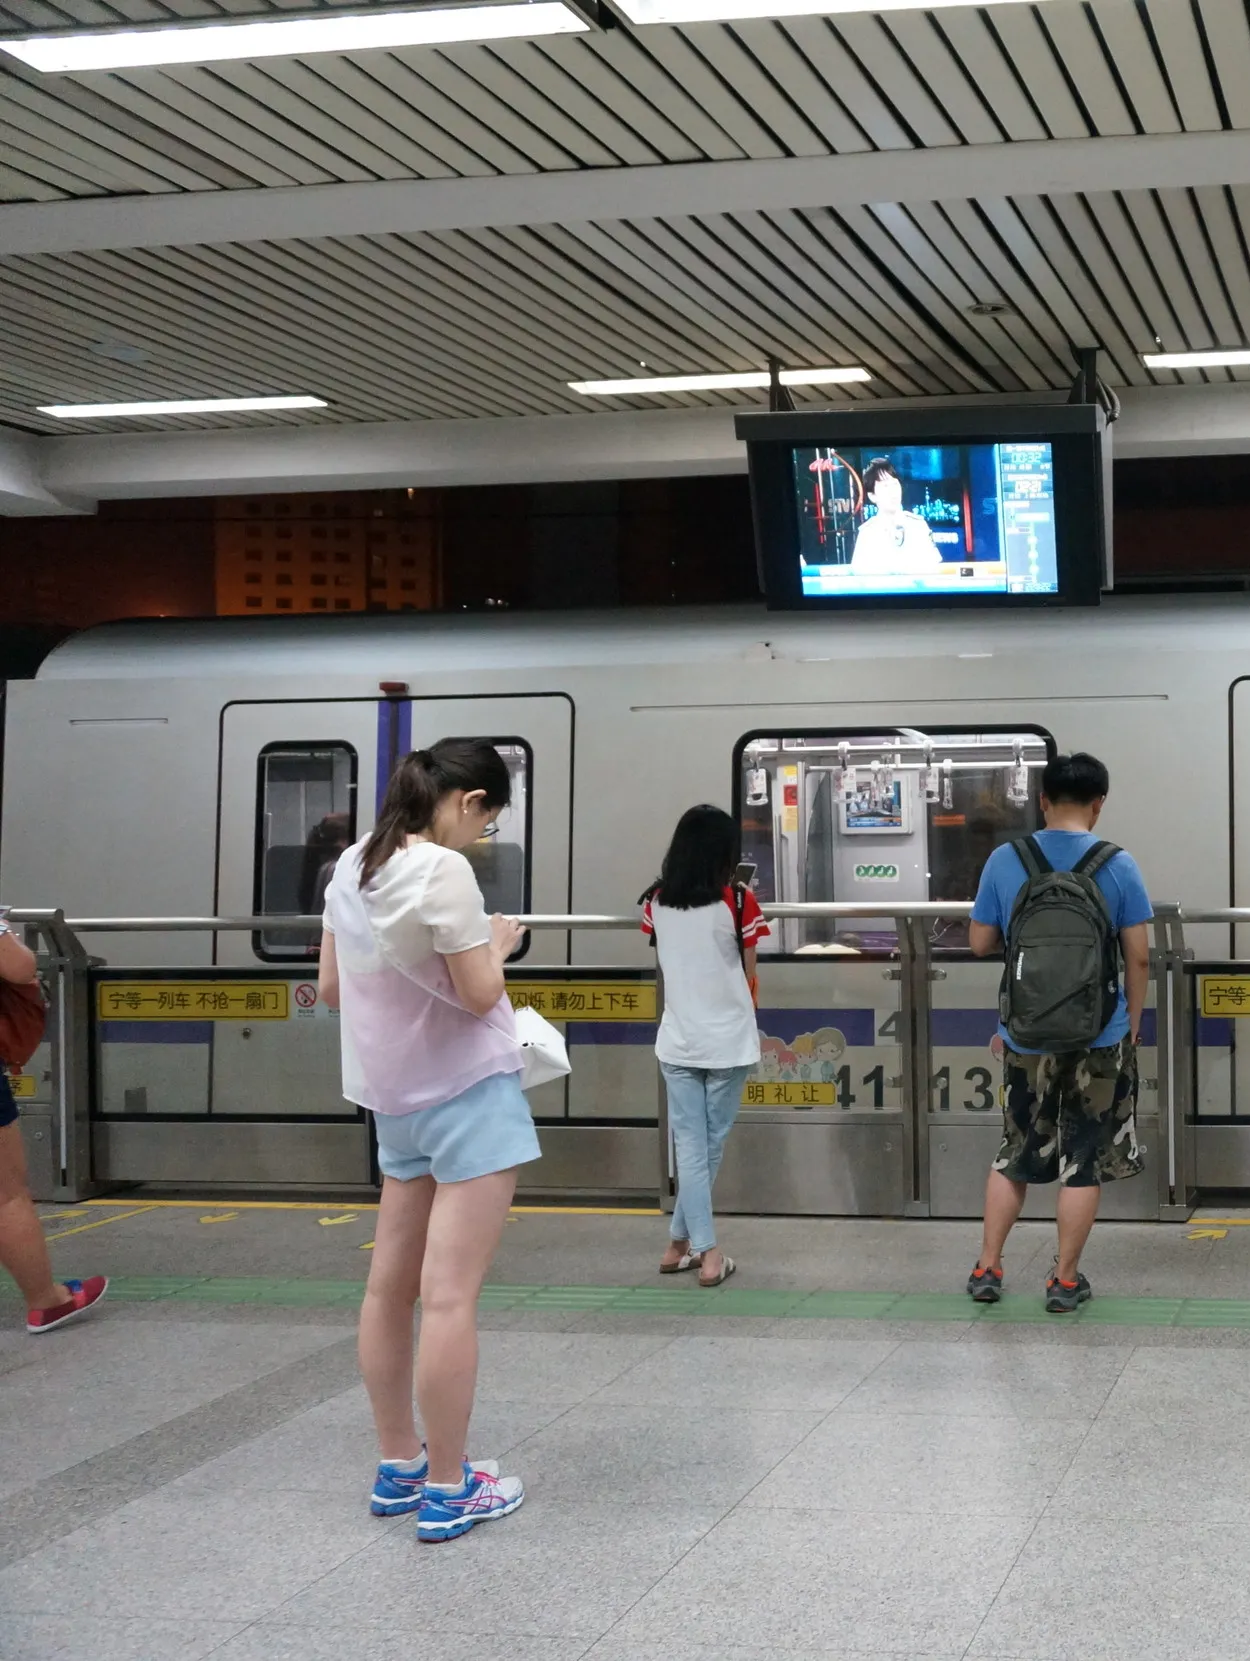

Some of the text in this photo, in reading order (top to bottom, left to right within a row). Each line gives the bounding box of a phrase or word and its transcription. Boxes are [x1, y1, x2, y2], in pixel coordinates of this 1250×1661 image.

[108, 991, 279, 1010] 宁等一列车 不抢一扇门
[507, 991, 639, 1011] 闪烁 请勿上下车
[878, 1011, 903, 1043] 4
